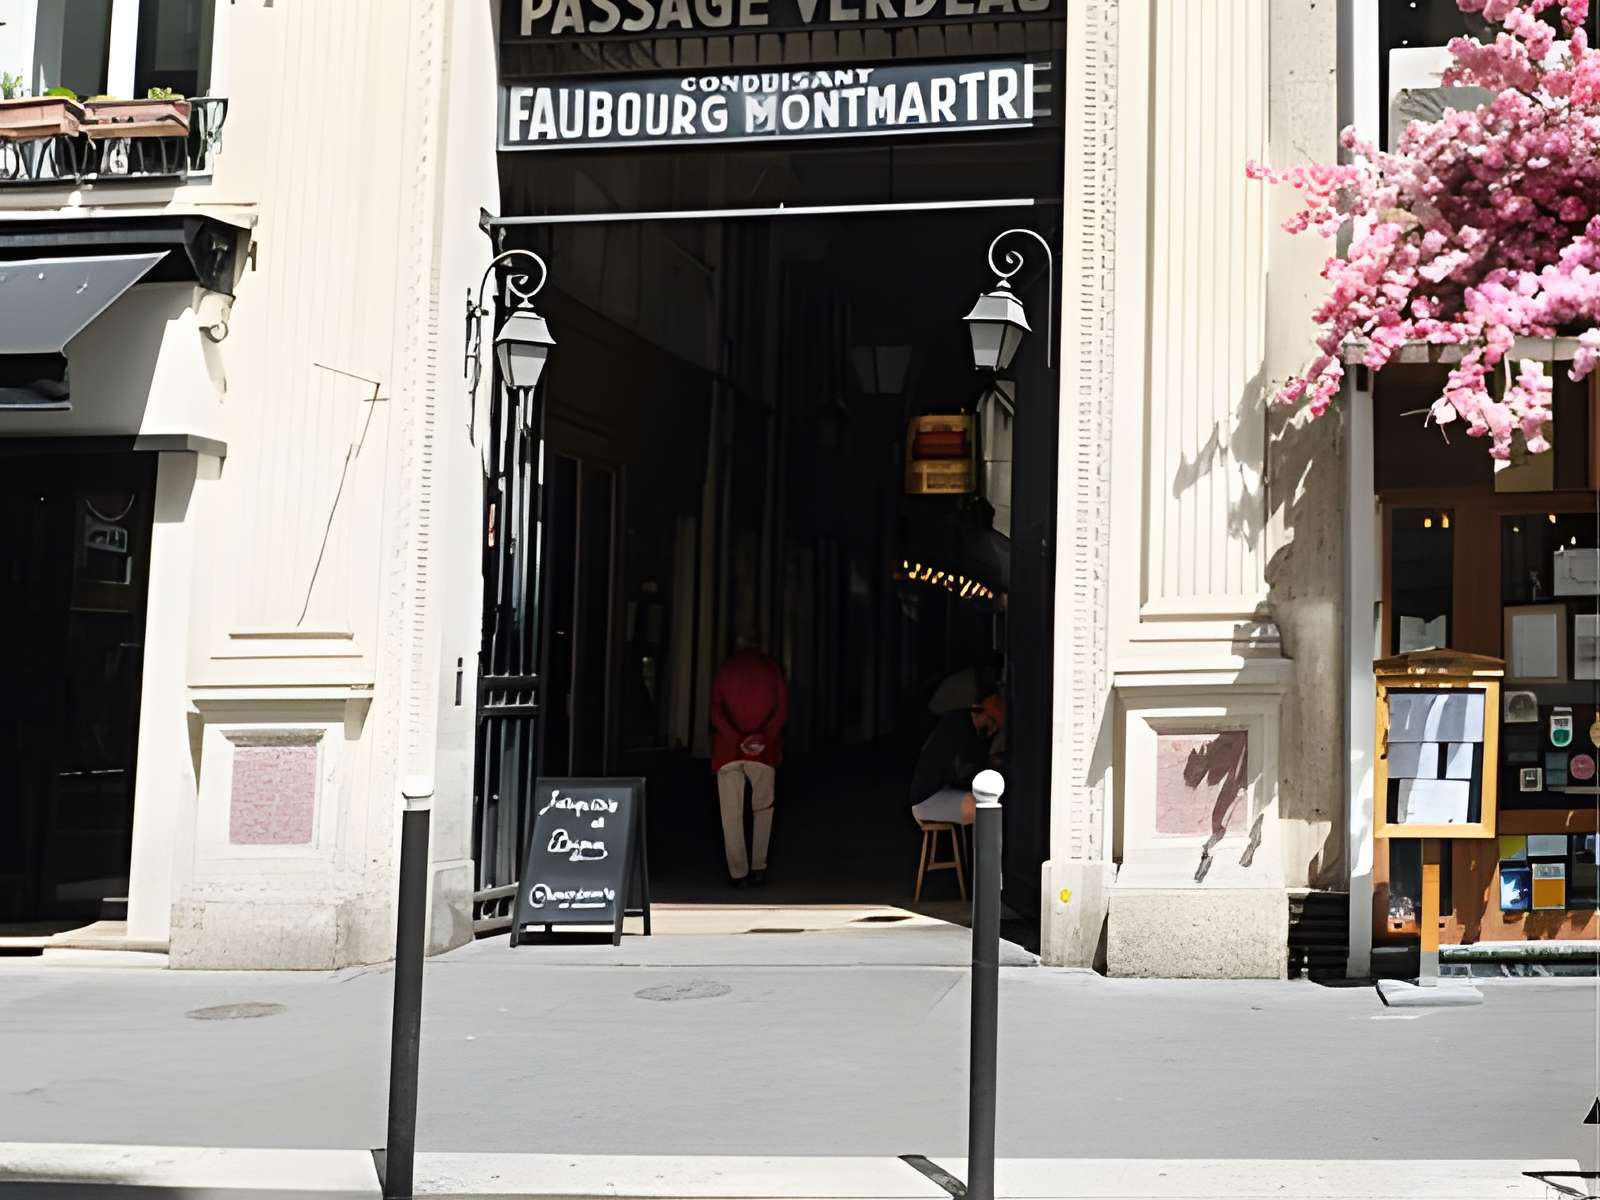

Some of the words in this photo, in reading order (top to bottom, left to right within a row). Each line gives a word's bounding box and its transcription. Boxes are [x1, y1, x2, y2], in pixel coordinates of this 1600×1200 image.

[508, 86, 729, 142] FAUBOURG
[745, 61, 1052, 134] MONTMARTRE
[680, 67, 875, 92] CONDUISANT
